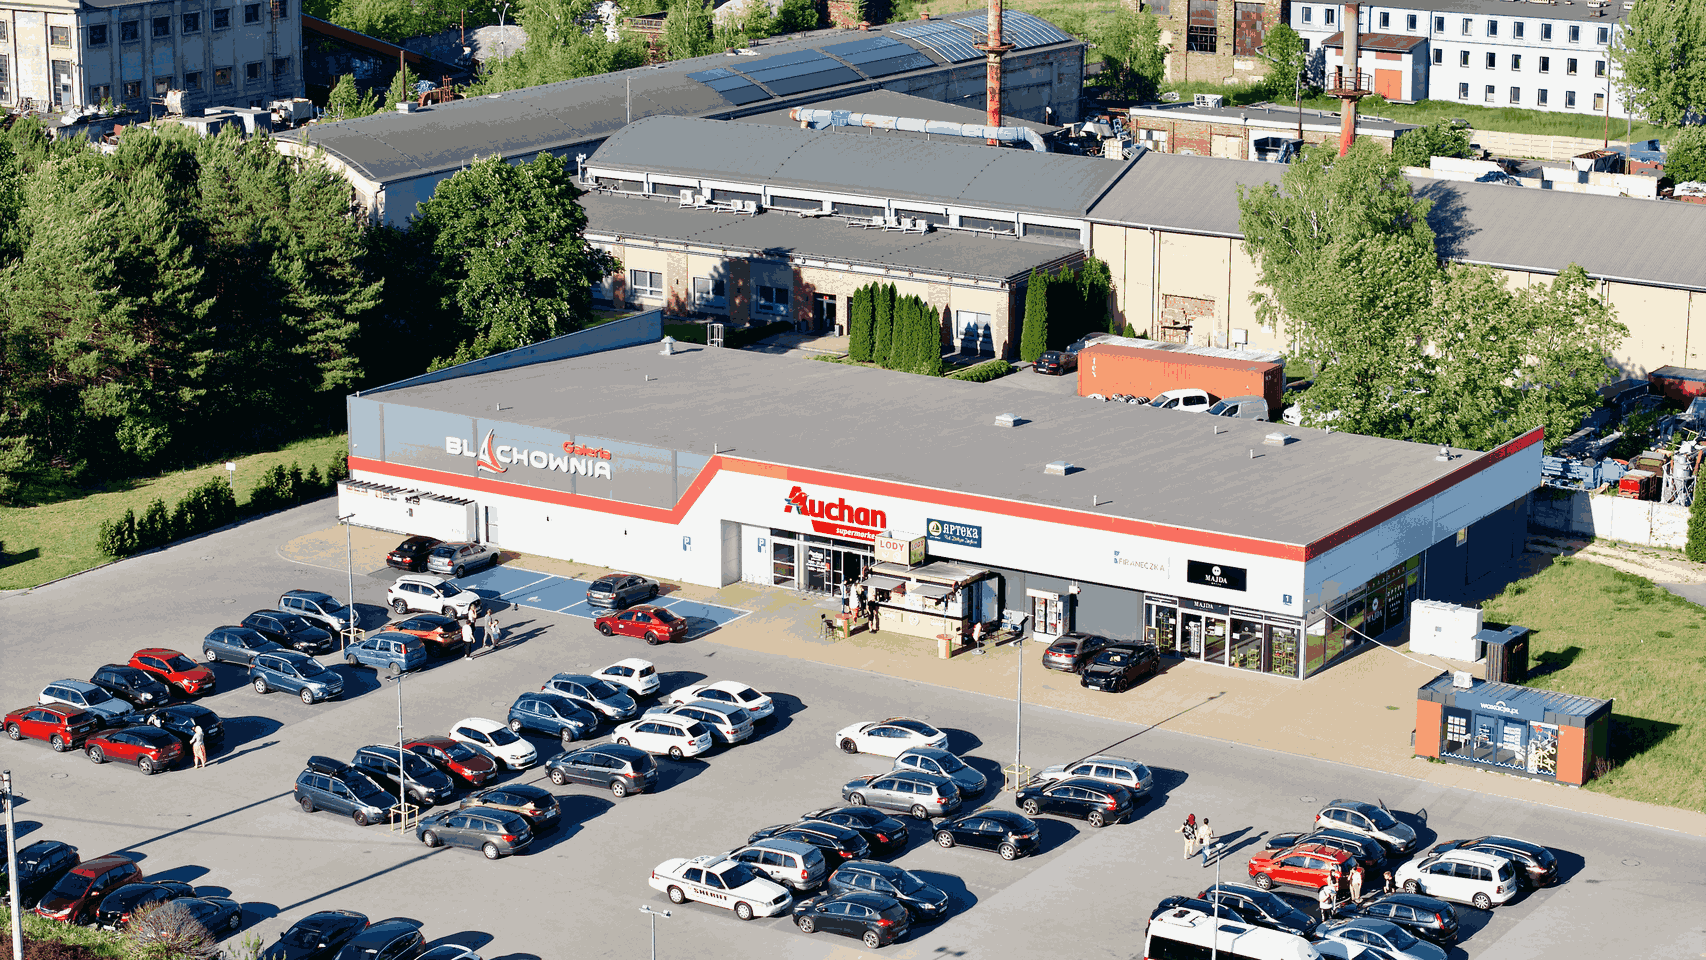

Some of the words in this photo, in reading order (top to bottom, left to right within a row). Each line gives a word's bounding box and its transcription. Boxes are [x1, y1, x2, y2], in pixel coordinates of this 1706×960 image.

[562, 441, 612, 460] Galeria
[784, 486, 887, 529] Auchan
[880, 540, 905, 552] LODY
[1118, 557, 1166, 572] FIRANECZKA
[1205, 574, 1228, 585] MAJDA
[1193, 601, 1214, 610] MAJDA
